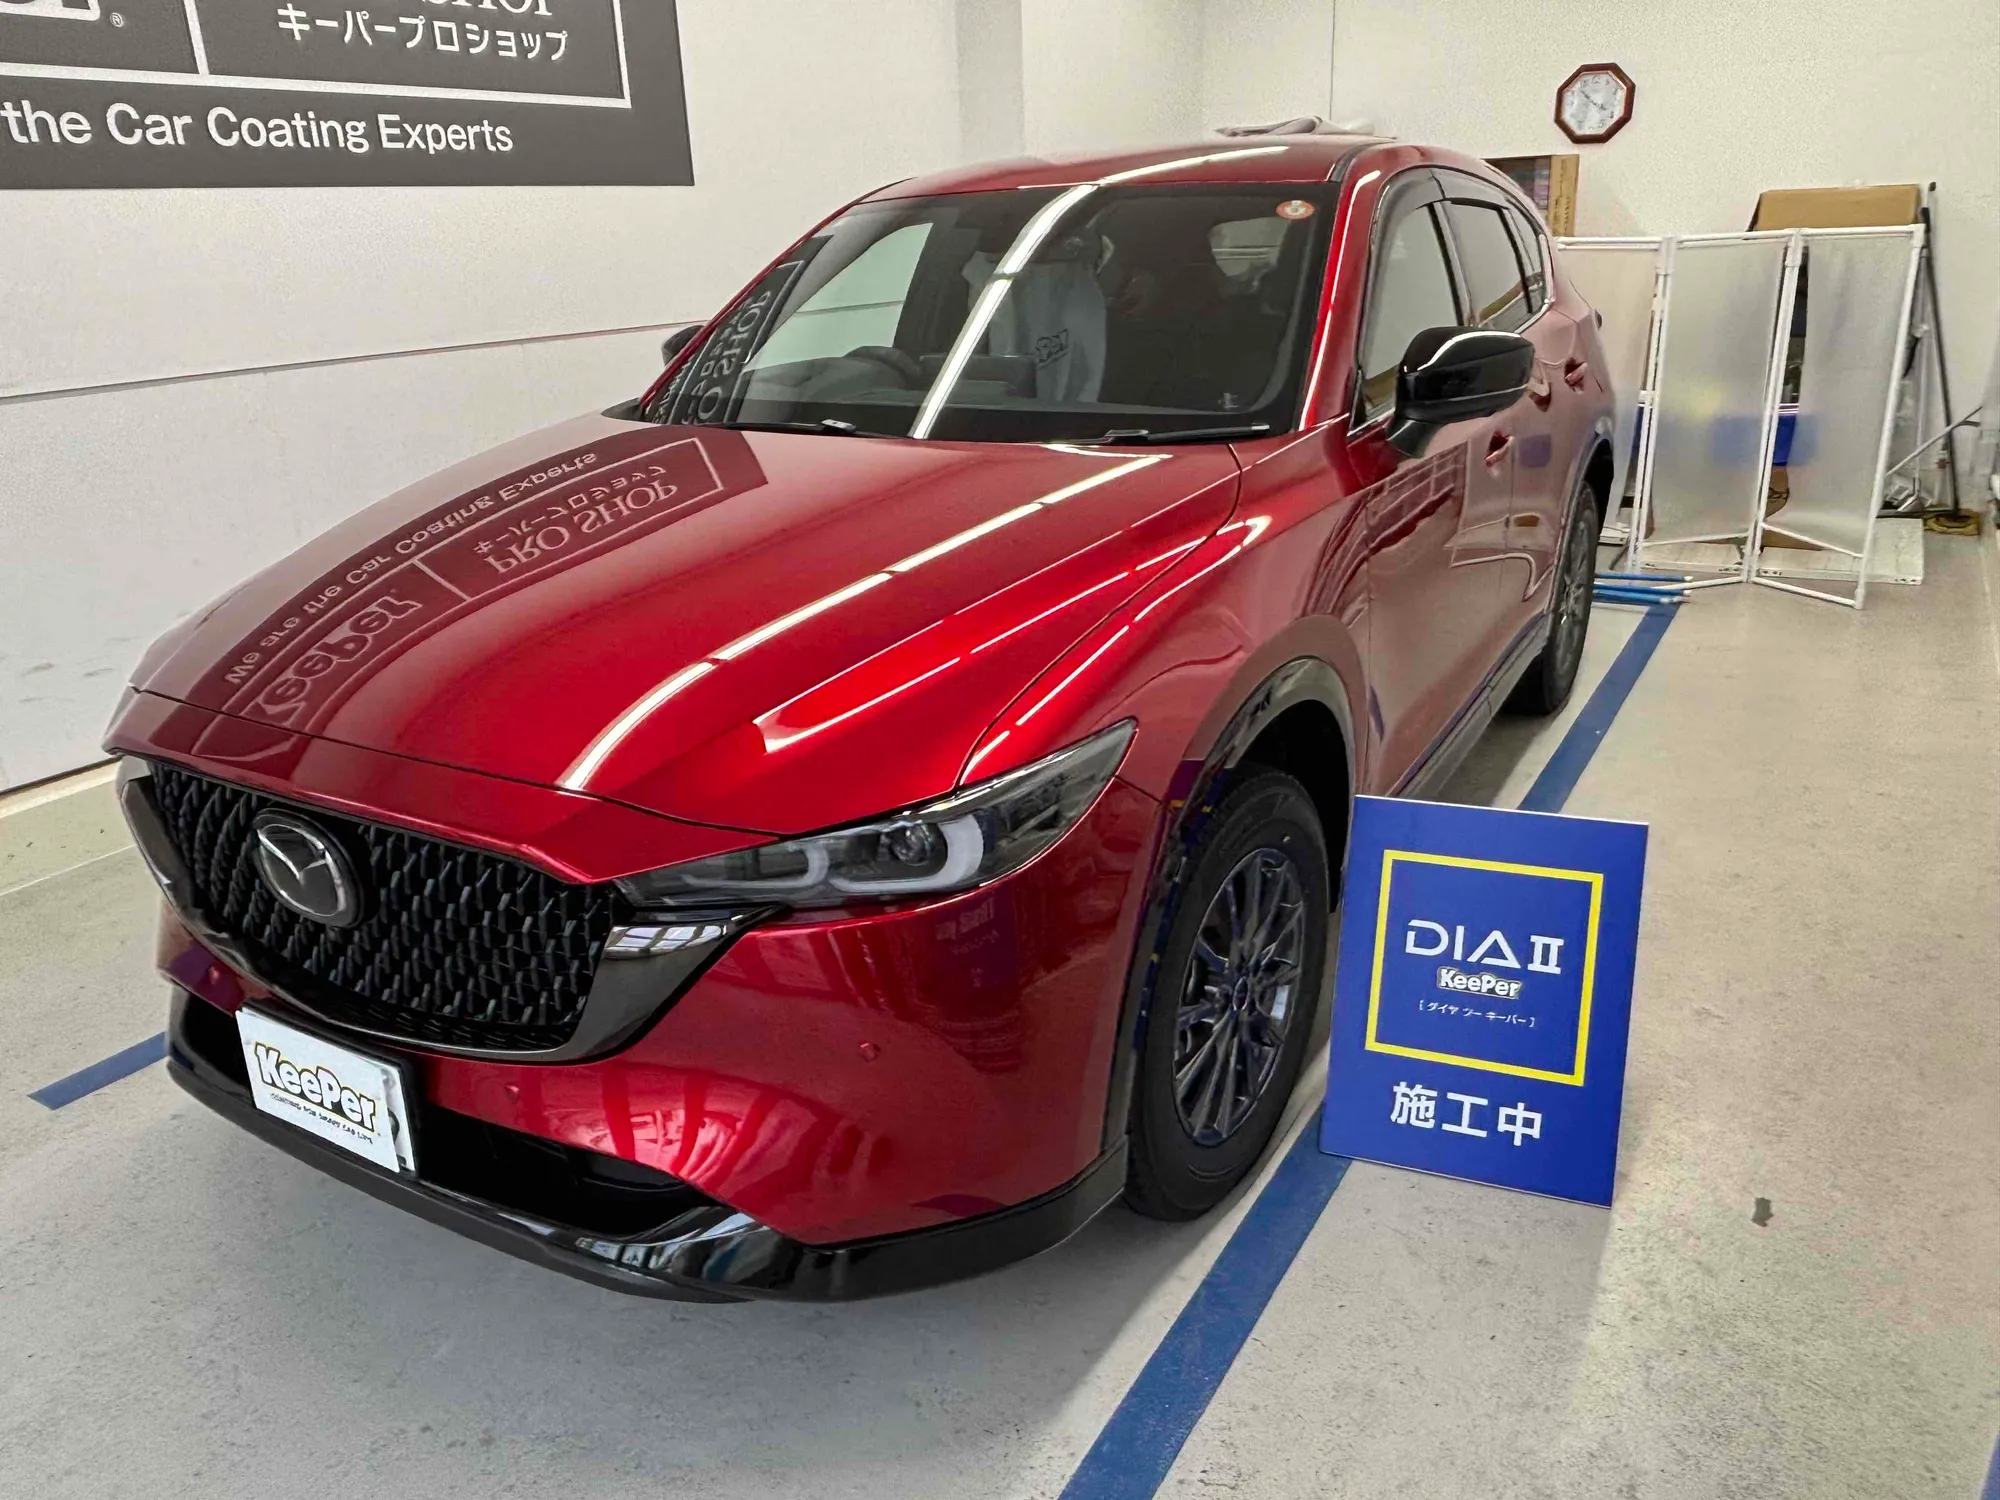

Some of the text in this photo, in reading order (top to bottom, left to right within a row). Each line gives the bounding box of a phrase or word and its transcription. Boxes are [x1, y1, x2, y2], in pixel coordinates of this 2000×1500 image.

[278, 3, 567, 60] キーパープロショップ
[0, 99, 513, 154] the Car Coating Experts
[1405, 919, 1521, 969] DIA
[1438, 966, 1521, 998] KeePer
[254, 1041, 376, 1133] KeePer
[1390, 1081, 1543, 1147] 施工中
